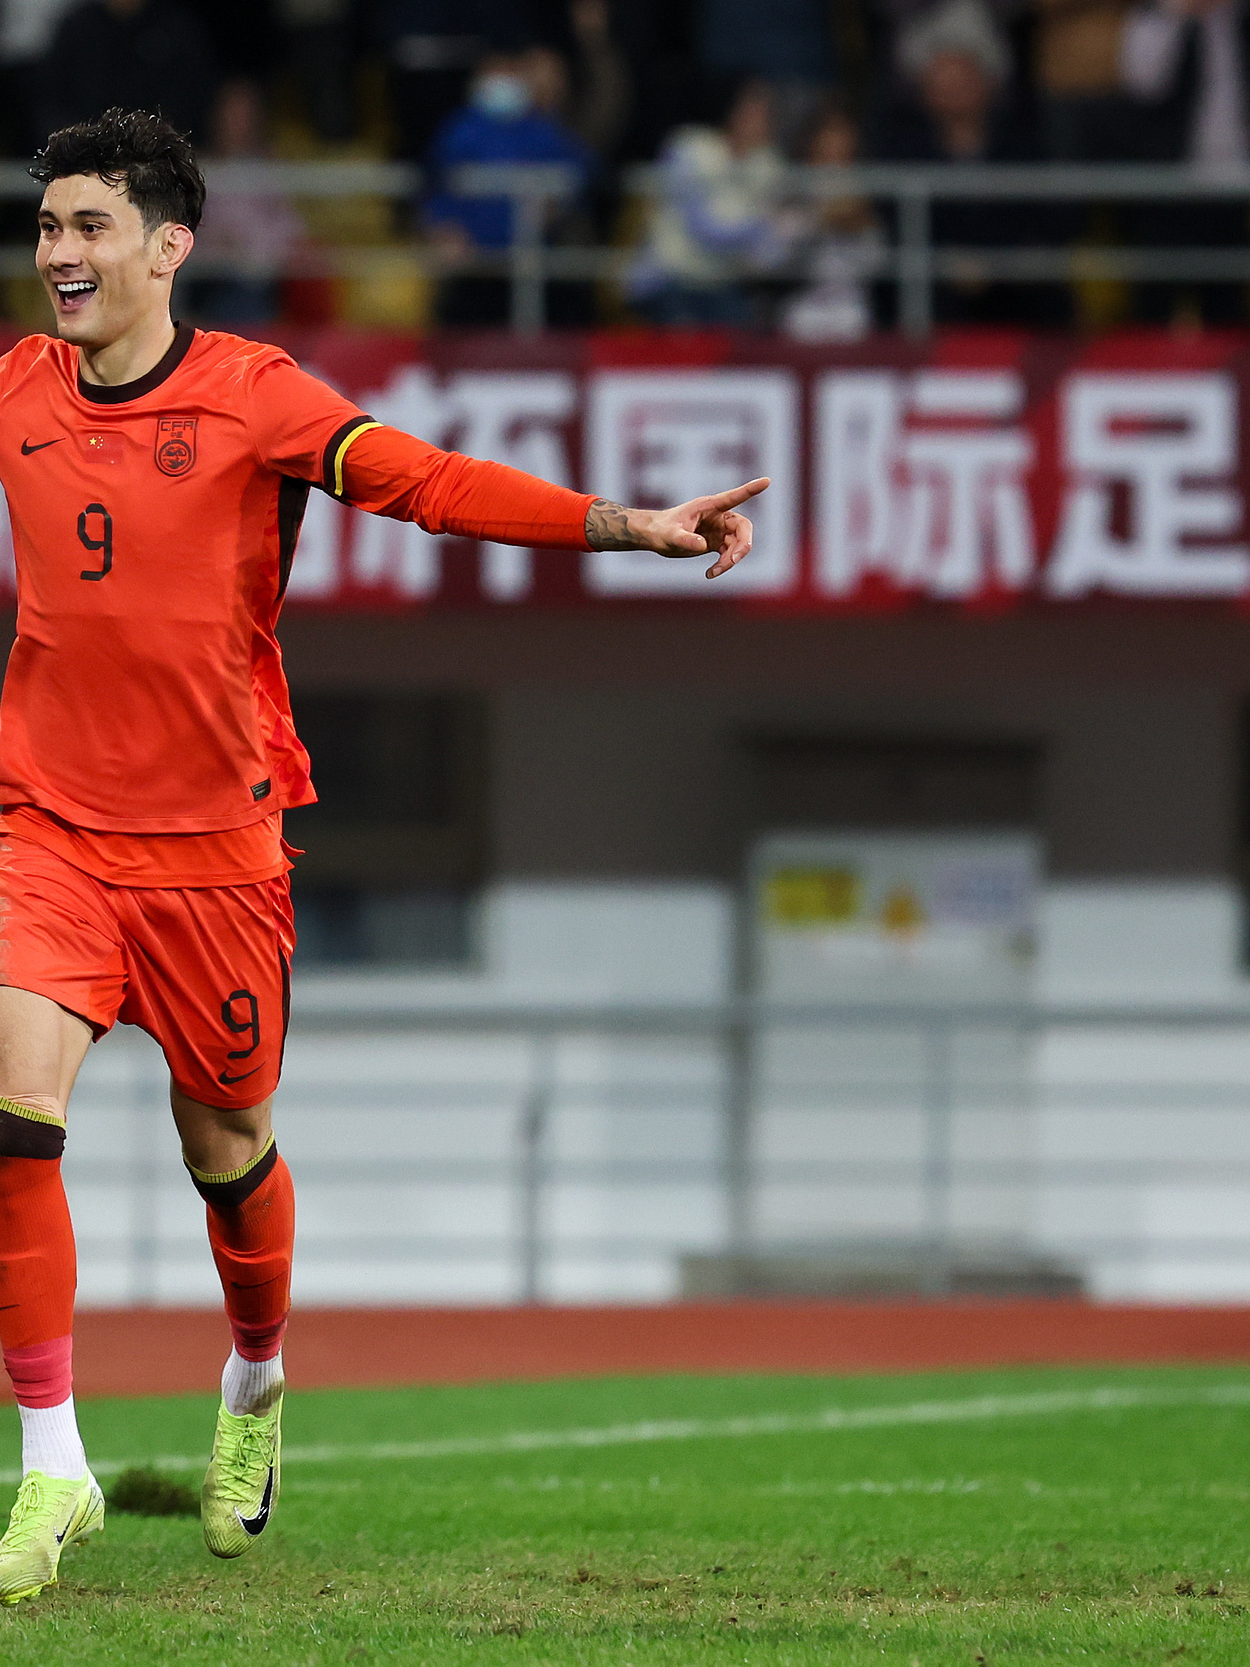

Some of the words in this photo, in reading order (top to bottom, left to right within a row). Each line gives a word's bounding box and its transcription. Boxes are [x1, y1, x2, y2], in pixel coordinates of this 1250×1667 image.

[160, 420, 194, 432] CFA
[76, 502, 113, 581] 9
[220, 988, 261, 1059] 9
